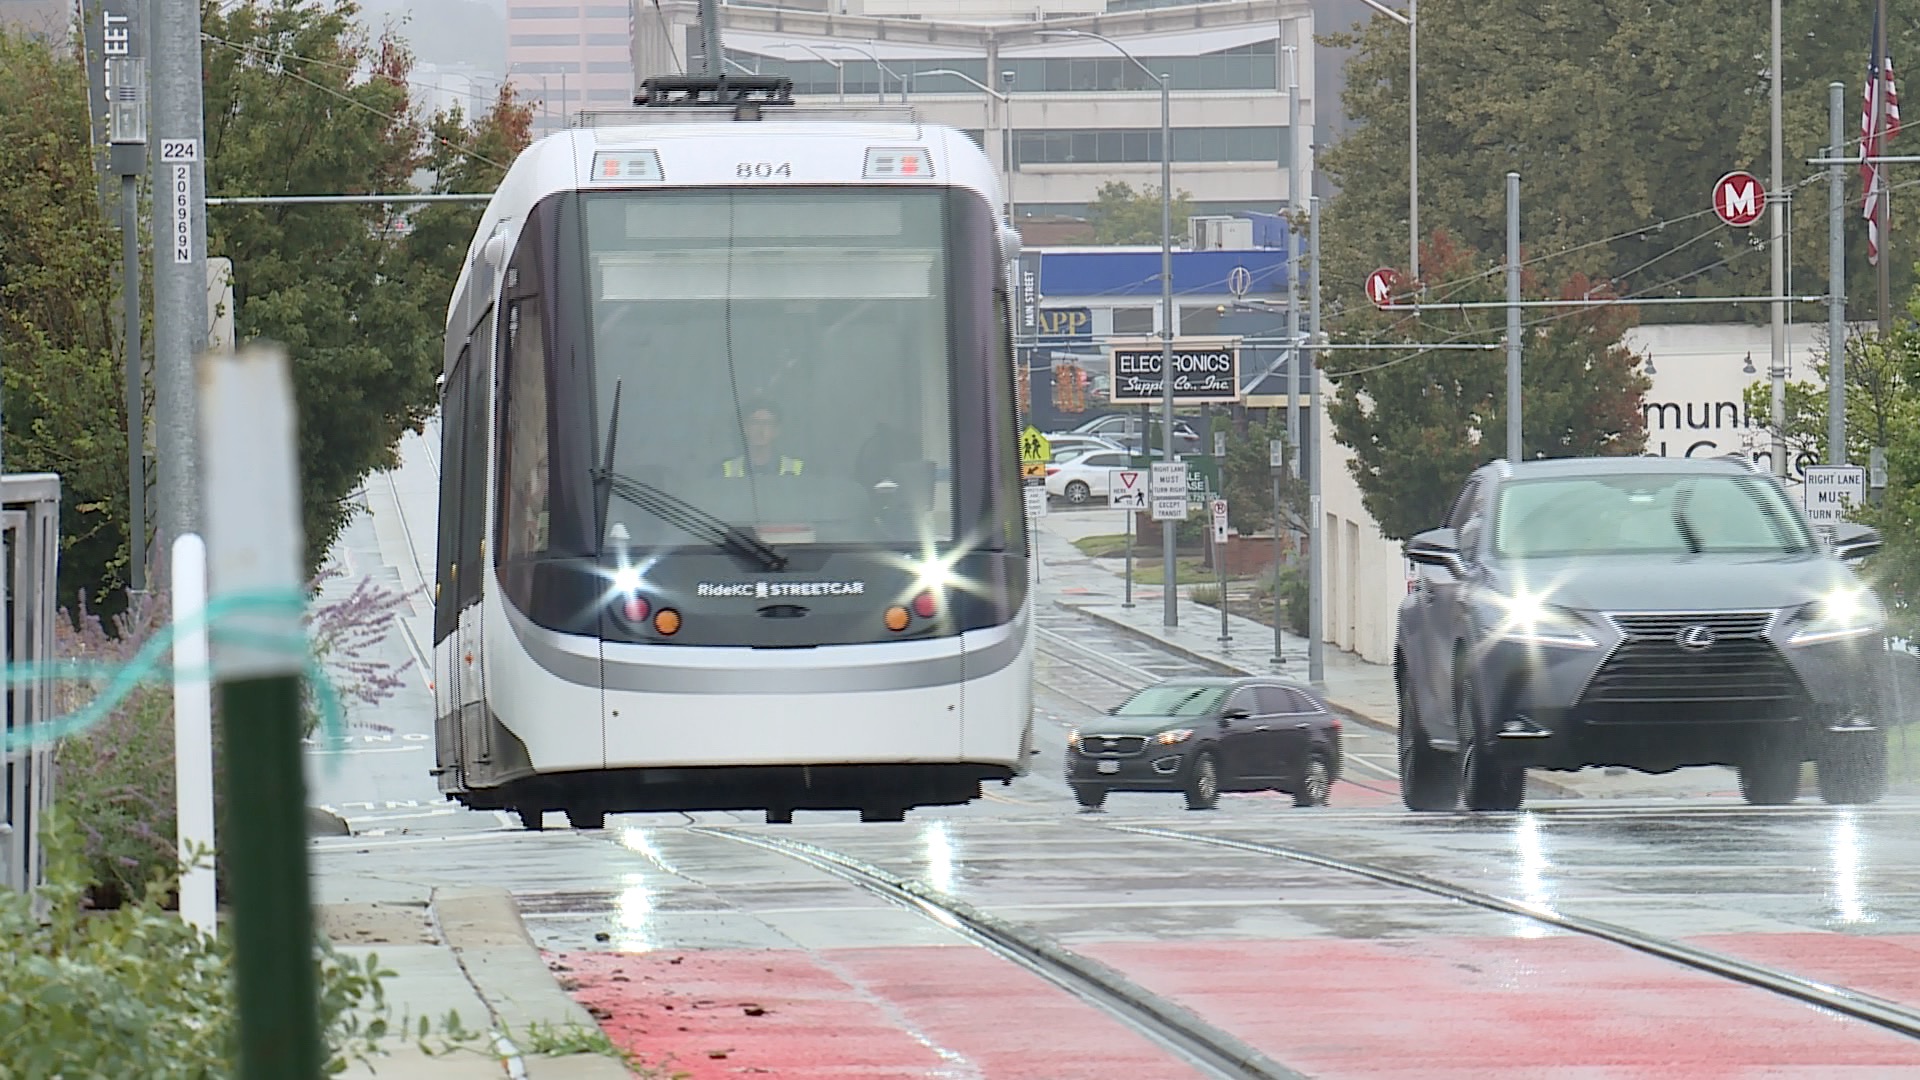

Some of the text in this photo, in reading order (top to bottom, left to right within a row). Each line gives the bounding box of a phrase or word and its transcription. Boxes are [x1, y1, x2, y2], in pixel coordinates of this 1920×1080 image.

[164, 143, 194, 158] 224
[736, 162, 792, 179] 804
[1024, 271, 1034, 327] MAIN STREET
[1120, 354, 1230, 373] ELECRONICS
[1122, 376, 1163, 396] Suppl
[1808, 475, 1861, 485] RIGHT LANE
[1808, 510, 1831, 519] TURN
[697, 581, 865, 596] RideKC STREETCAR
